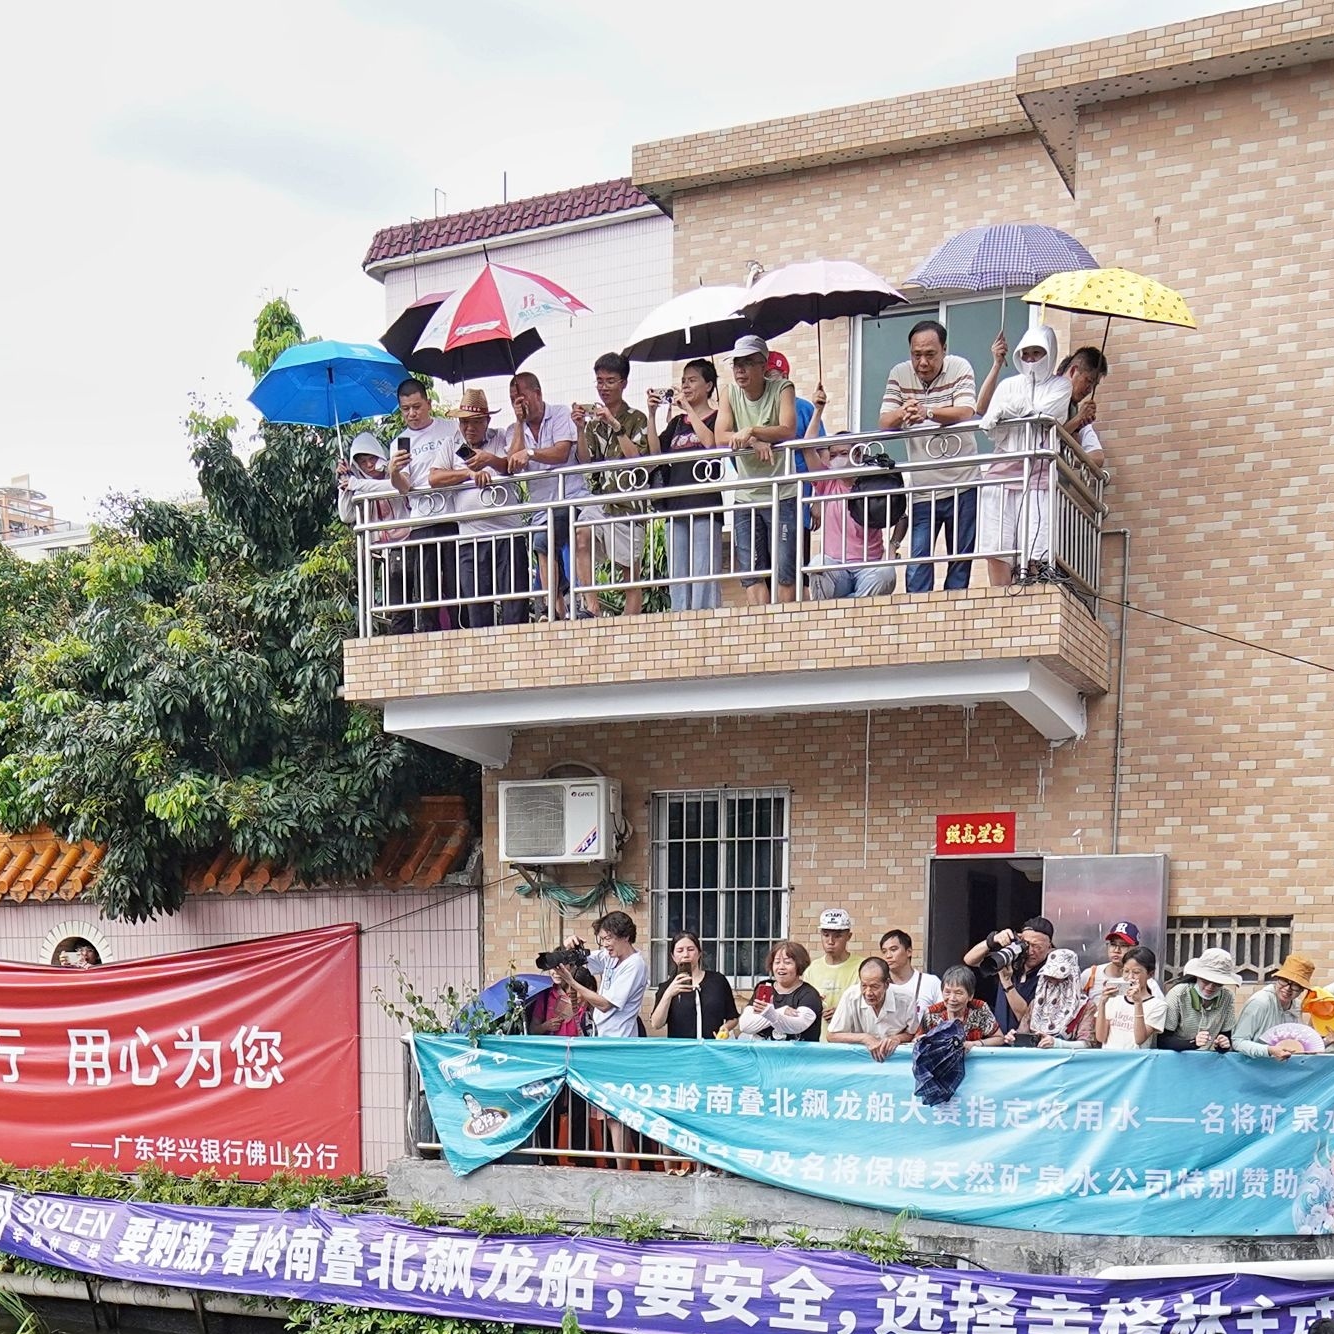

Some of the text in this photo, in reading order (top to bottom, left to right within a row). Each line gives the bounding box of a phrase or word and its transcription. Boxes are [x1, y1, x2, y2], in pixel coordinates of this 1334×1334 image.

[67, 1025, 287, 1090] 用心为您
[17, 1198, 116, 1240] SIGLEN
